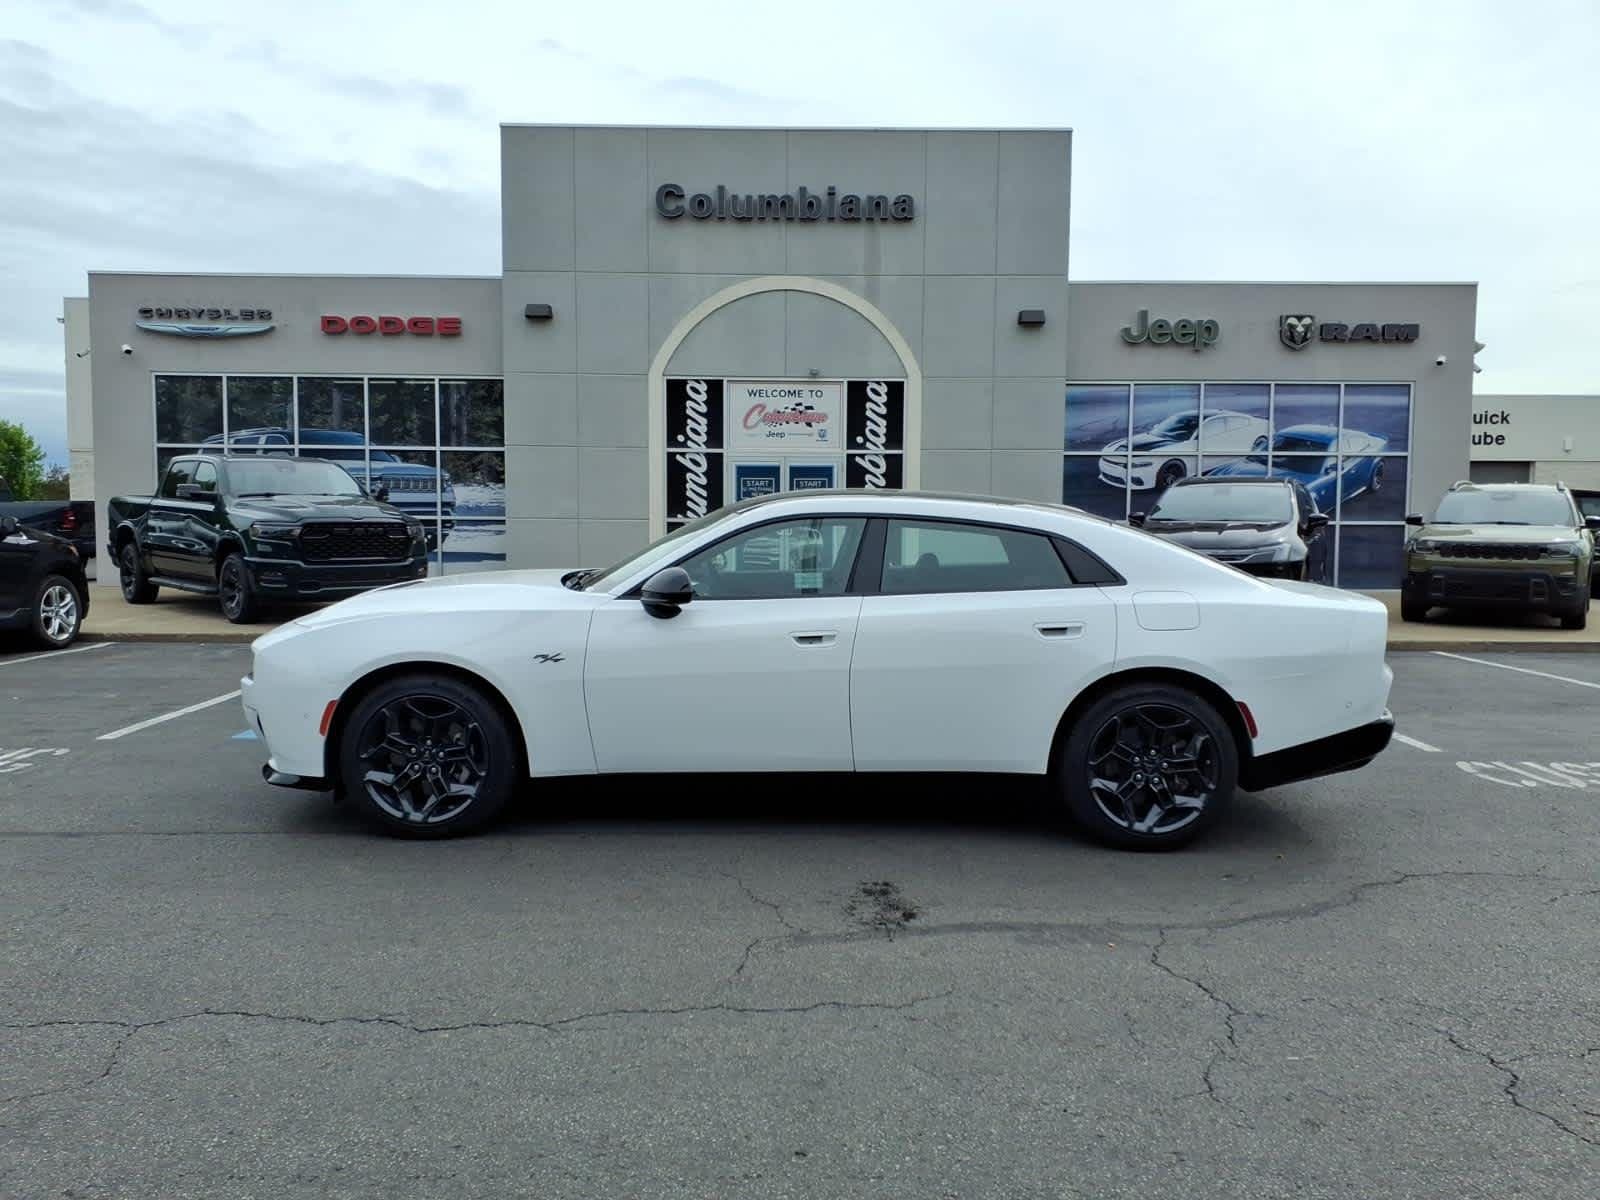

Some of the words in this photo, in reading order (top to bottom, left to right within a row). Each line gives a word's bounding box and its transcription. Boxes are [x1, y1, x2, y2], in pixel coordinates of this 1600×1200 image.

[655, 183, 915, 222] Columbiana
[138, 308, 272, 320] CHRYSLER
[320, 315, 462, 335] DODGE
[1120, 309, 1220, 351] Jeep
[1319, 323, 1420, 343] RAM
[747, 389, 804, 398] WELCOME
[808, 389, 824, 398] TO
[766, 430, 786, 439] Jeep
